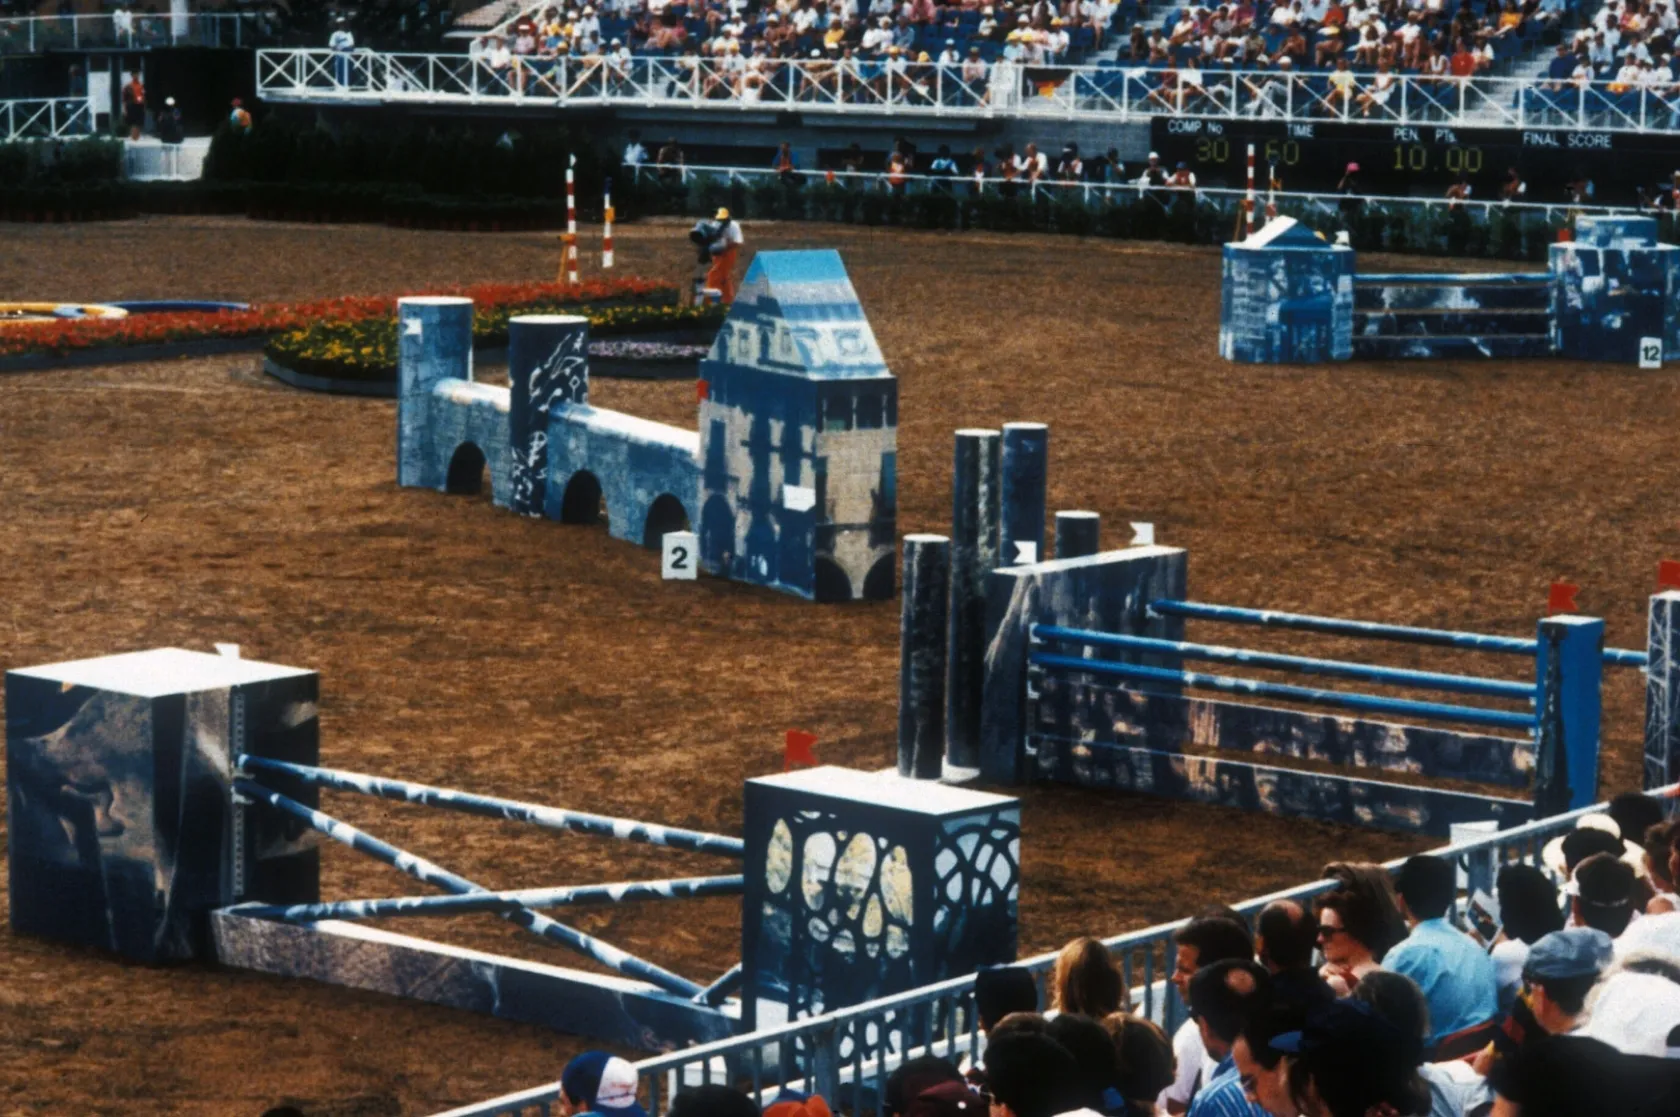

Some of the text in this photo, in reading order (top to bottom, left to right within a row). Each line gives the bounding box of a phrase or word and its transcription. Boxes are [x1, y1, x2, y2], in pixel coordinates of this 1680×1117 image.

[1167, 120, 1202, 132] COMP
[1286, 123, 1314, 137] TIME
[1523, 131, 1612, 148] FINAL SCORE
[1196, 137, 1229, 162] 30
[1643, 345, 1660, 361] 12
[671, 546, 688, 569] 2
